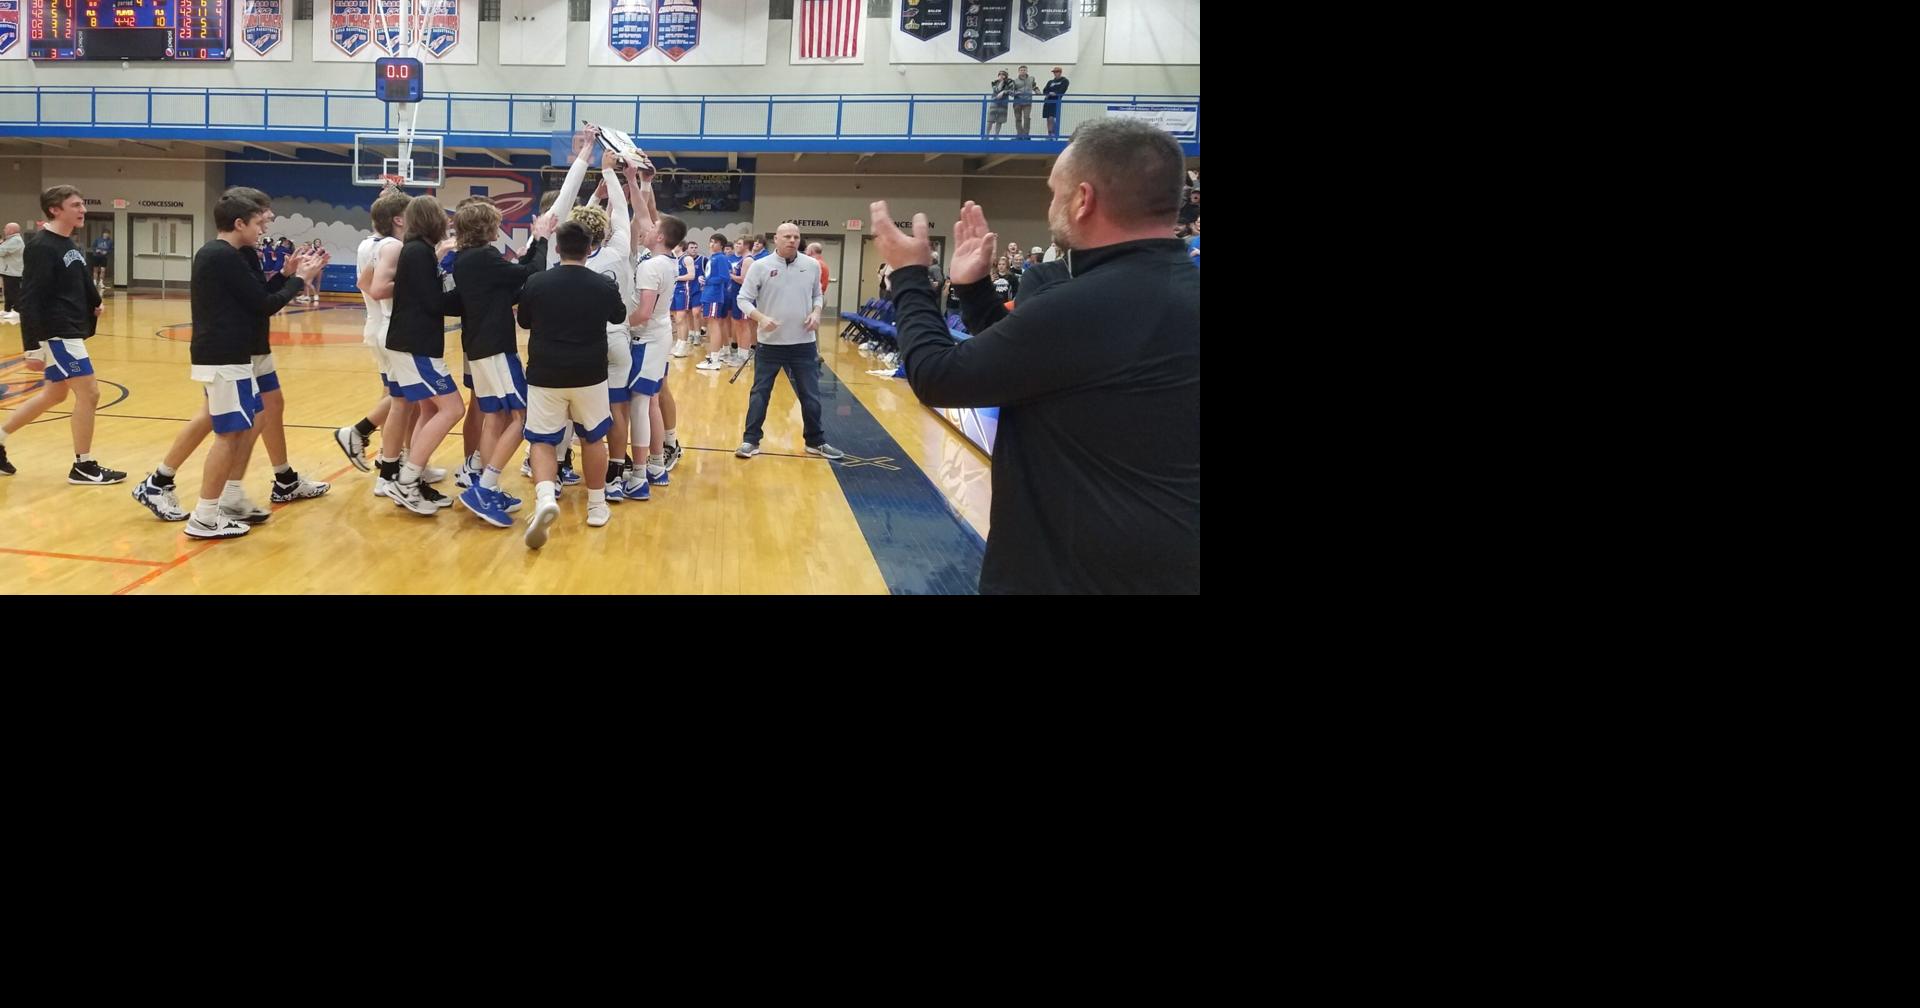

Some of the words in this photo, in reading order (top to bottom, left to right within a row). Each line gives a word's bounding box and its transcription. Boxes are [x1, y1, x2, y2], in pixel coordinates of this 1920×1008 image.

[90, 17, 97, 27] 8
[156, 17, 166, 27] 10
[51, 49, 57, 58] 3
[200, 48, 207, 58] 0
[387, 65, 408, 78] 0.0
[142, 200, 184, 208] CONCESSION
